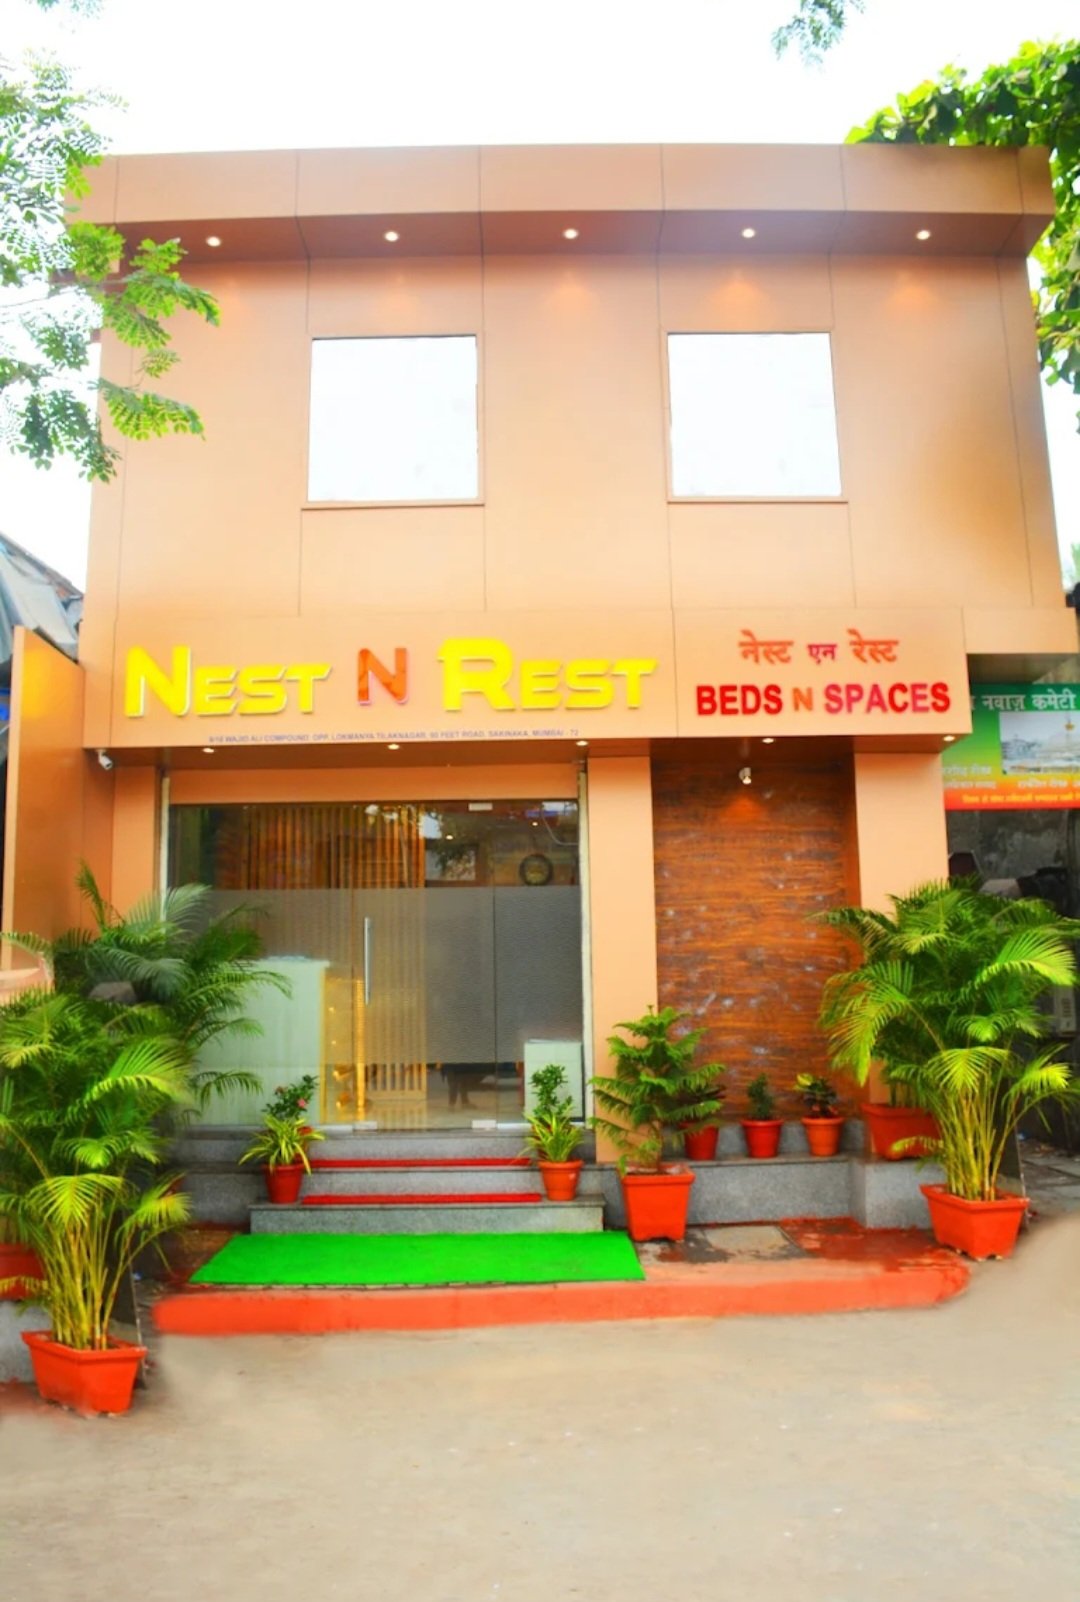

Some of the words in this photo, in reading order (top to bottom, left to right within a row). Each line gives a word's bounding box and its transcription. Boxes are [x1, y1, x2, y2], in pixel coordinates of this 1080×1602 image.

[738, 629, 794, 664] नेस्ट
[807, 643, 837, 664] एन
[847, 628, 900, 663] रेस्ट
[357, 646, 408, 705] N
[696, 684, 783, 716] BEDS
[792, 687, 813, 711] N
[824, 682, 951, 714] SPACES
[1031, 688, 1077, 710] कमेटी
